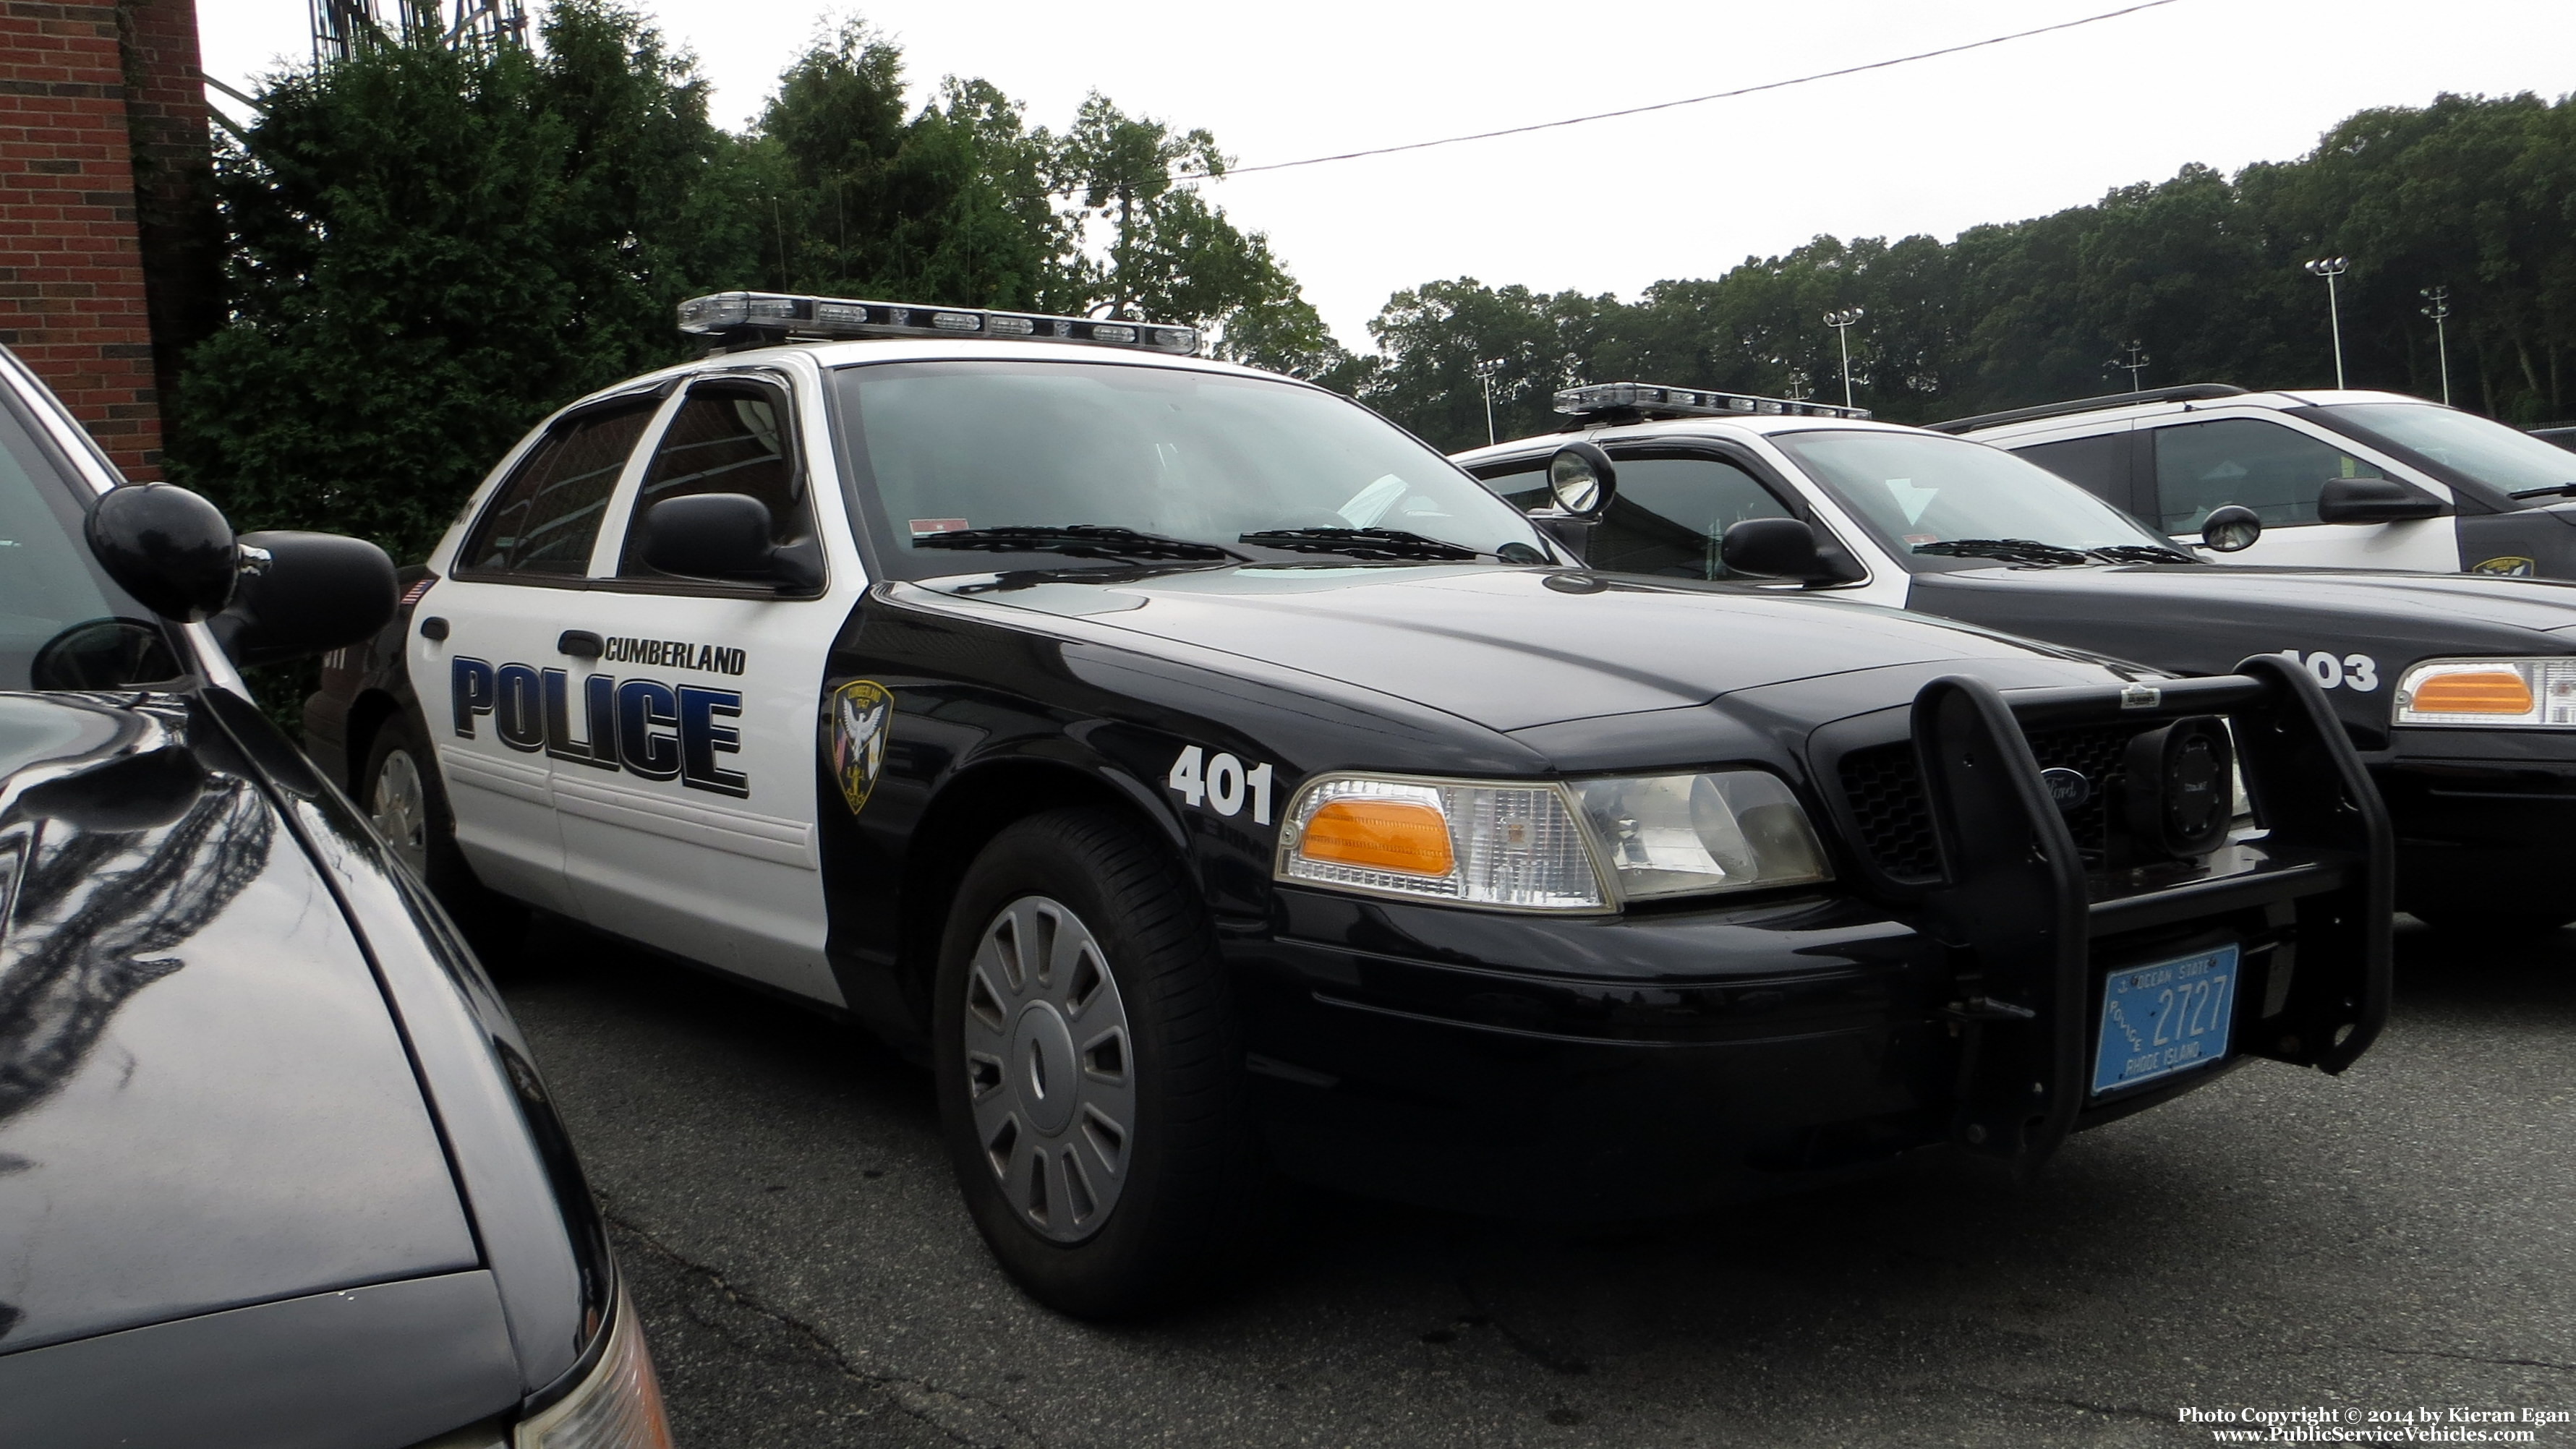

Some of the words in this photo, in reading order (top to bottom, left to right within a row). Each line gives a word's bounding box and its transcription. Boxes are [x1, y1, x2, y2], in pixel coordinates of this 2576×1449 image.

[605, 637, 746, 676] CUMBERLAND
[451, 655, 750, 799] POLICE
[1169, 745, 1273, 826] 401
[2045, 776, 2077, 800] Ford
[2138, 971, 2172, 989] OCEAN
[2179, 960, 2209, 979] STATE
[2110, 1001, 2142, 1051] POLICE
[2153, 975, 2227, 1046] 2727
[2126, 1052, 2159, 1074] RHODE
[2165, 1042, 2199, 1065] ISLAND
